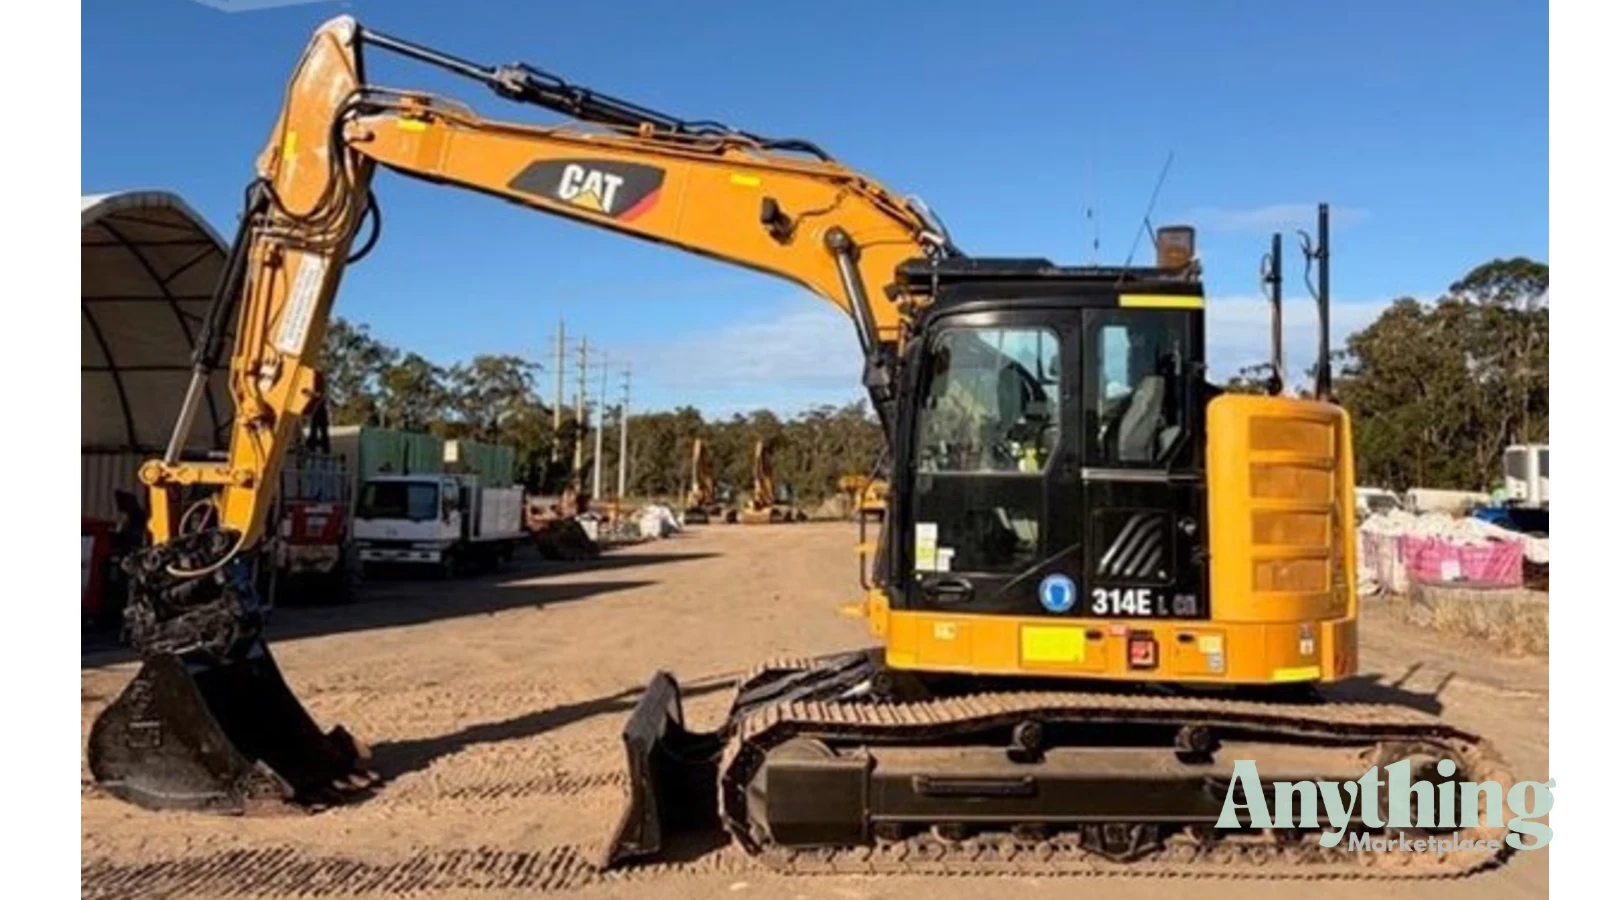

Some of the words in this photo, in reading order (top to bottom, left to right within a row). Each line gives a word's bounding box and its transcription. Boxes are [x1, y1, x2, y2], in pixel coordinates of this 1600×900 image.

[558, 163, 624, 213] CAT
[1091, 587, 1152, 615] 314E
[1157, 595, 1168, 615] L
